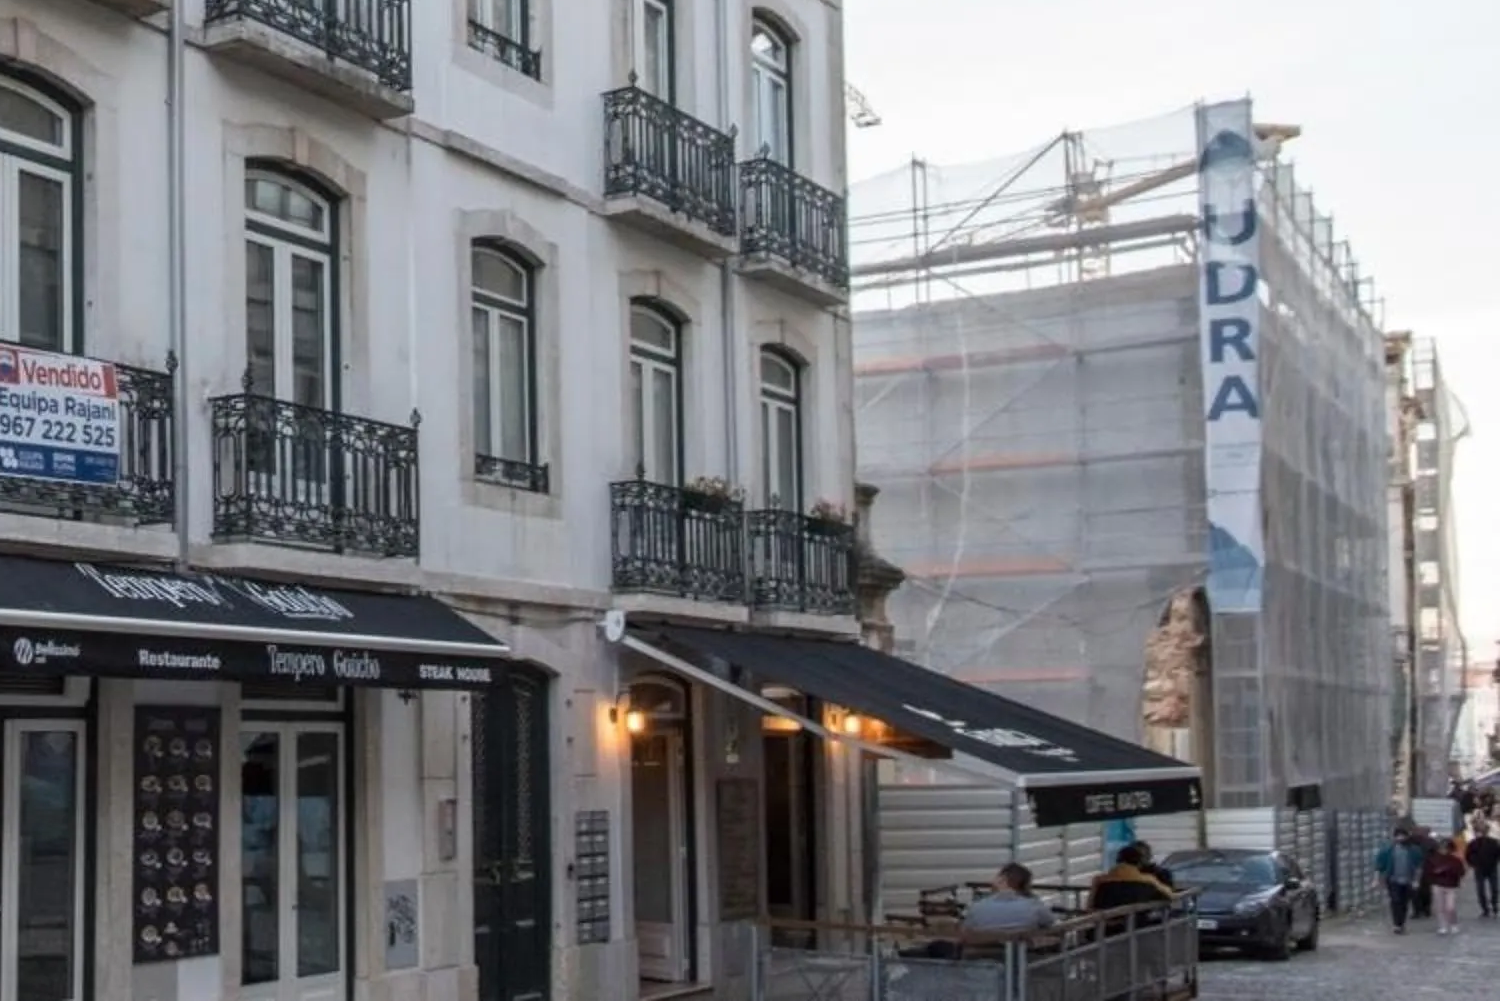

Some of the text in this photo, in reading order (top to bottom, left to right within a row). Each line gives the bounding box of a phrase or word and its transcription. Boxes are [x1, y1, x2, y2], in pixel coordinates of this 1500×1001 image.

[1203, 198, 1260, 422] UDRA
[22, 359, 101, 390] Vendido
[64, 397, 116, 421] Rajani
[0, 414, 115, 447] 967 222 525
[75, 562, 221, 608] Tempero
[138, 648, 223, 670] Restaurante
[266, 644, 325, 681] Tempero
[419, 664, 492, 683] STEAK HOUSE
